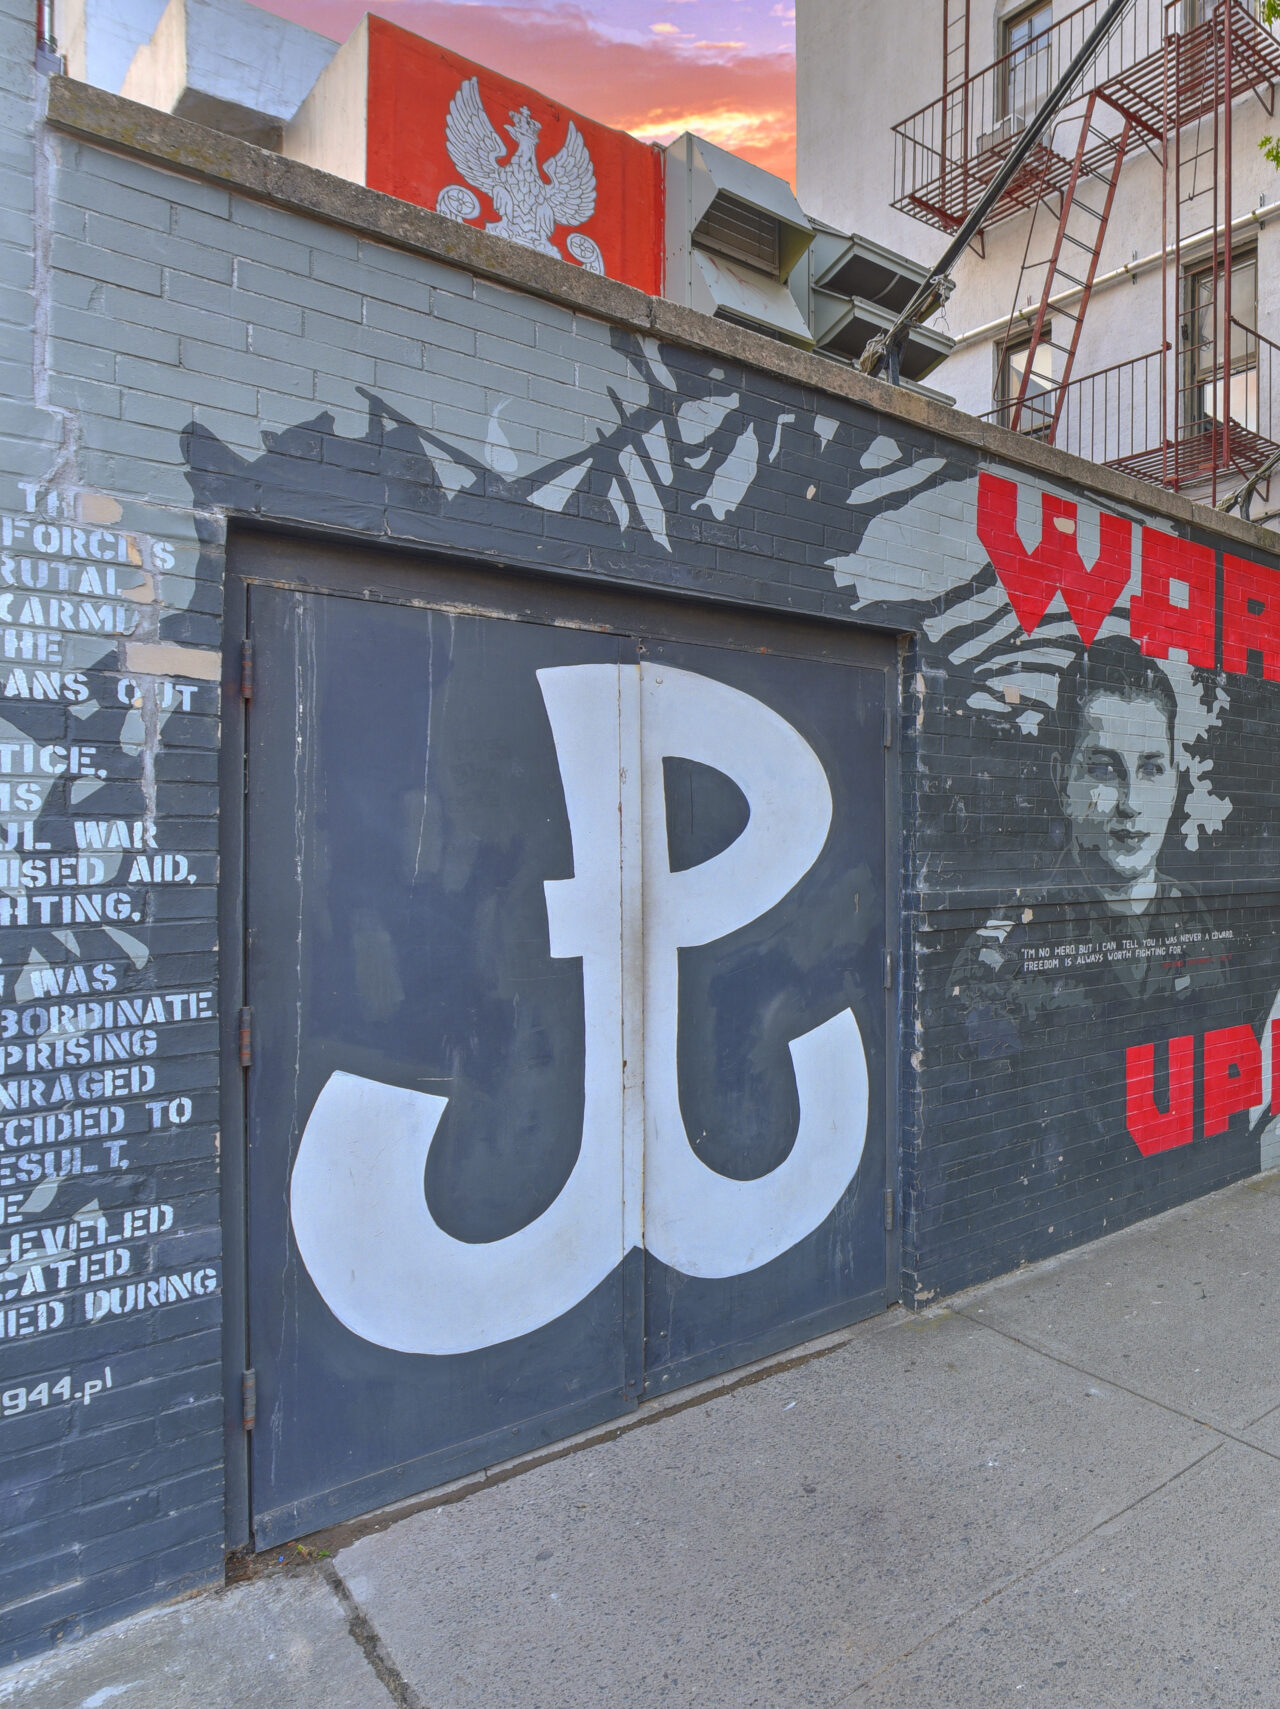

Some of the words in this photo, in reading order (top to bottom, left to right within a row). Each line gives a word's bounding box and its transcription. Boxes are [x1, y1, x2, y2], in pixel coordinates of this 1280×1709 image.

[0, 627, 62, 662] HE
[4, 668, 89, 701] ANS
[73, 820, 158, 850] WAR
[0, 857, 105, 888] ISED
[128, 854, 198, 885] AID,
[1024, 958, 1059, 972] FREEDOM
[1064, 957, 1072, 967] IS
[1076, 953, 1104, 965] ALWAYS
[1107, 950, 1132, 961] WORTH
[1135, 946, 1166, 957] FIGHTING
[1038, 947, 1050, 957] NO
[1079, 943, 1093, 954] BUT
[1102, 941, 1117, 951] CAN
[1122, 939, 1138, 949] TELL
[1142, 938, 1156, 947] YOU
[1165, 935, 1177, 945] WAS
[1180, 933, 1202, 943] NEVER
[1204, 933, 1209, 941] A
[30, 963, 117, 998] WAS
[0, 1105, 125, 1151] CIDED
[145, 1097, 192, 1128] TO
[84, 1268, 217, 1321] DURING
